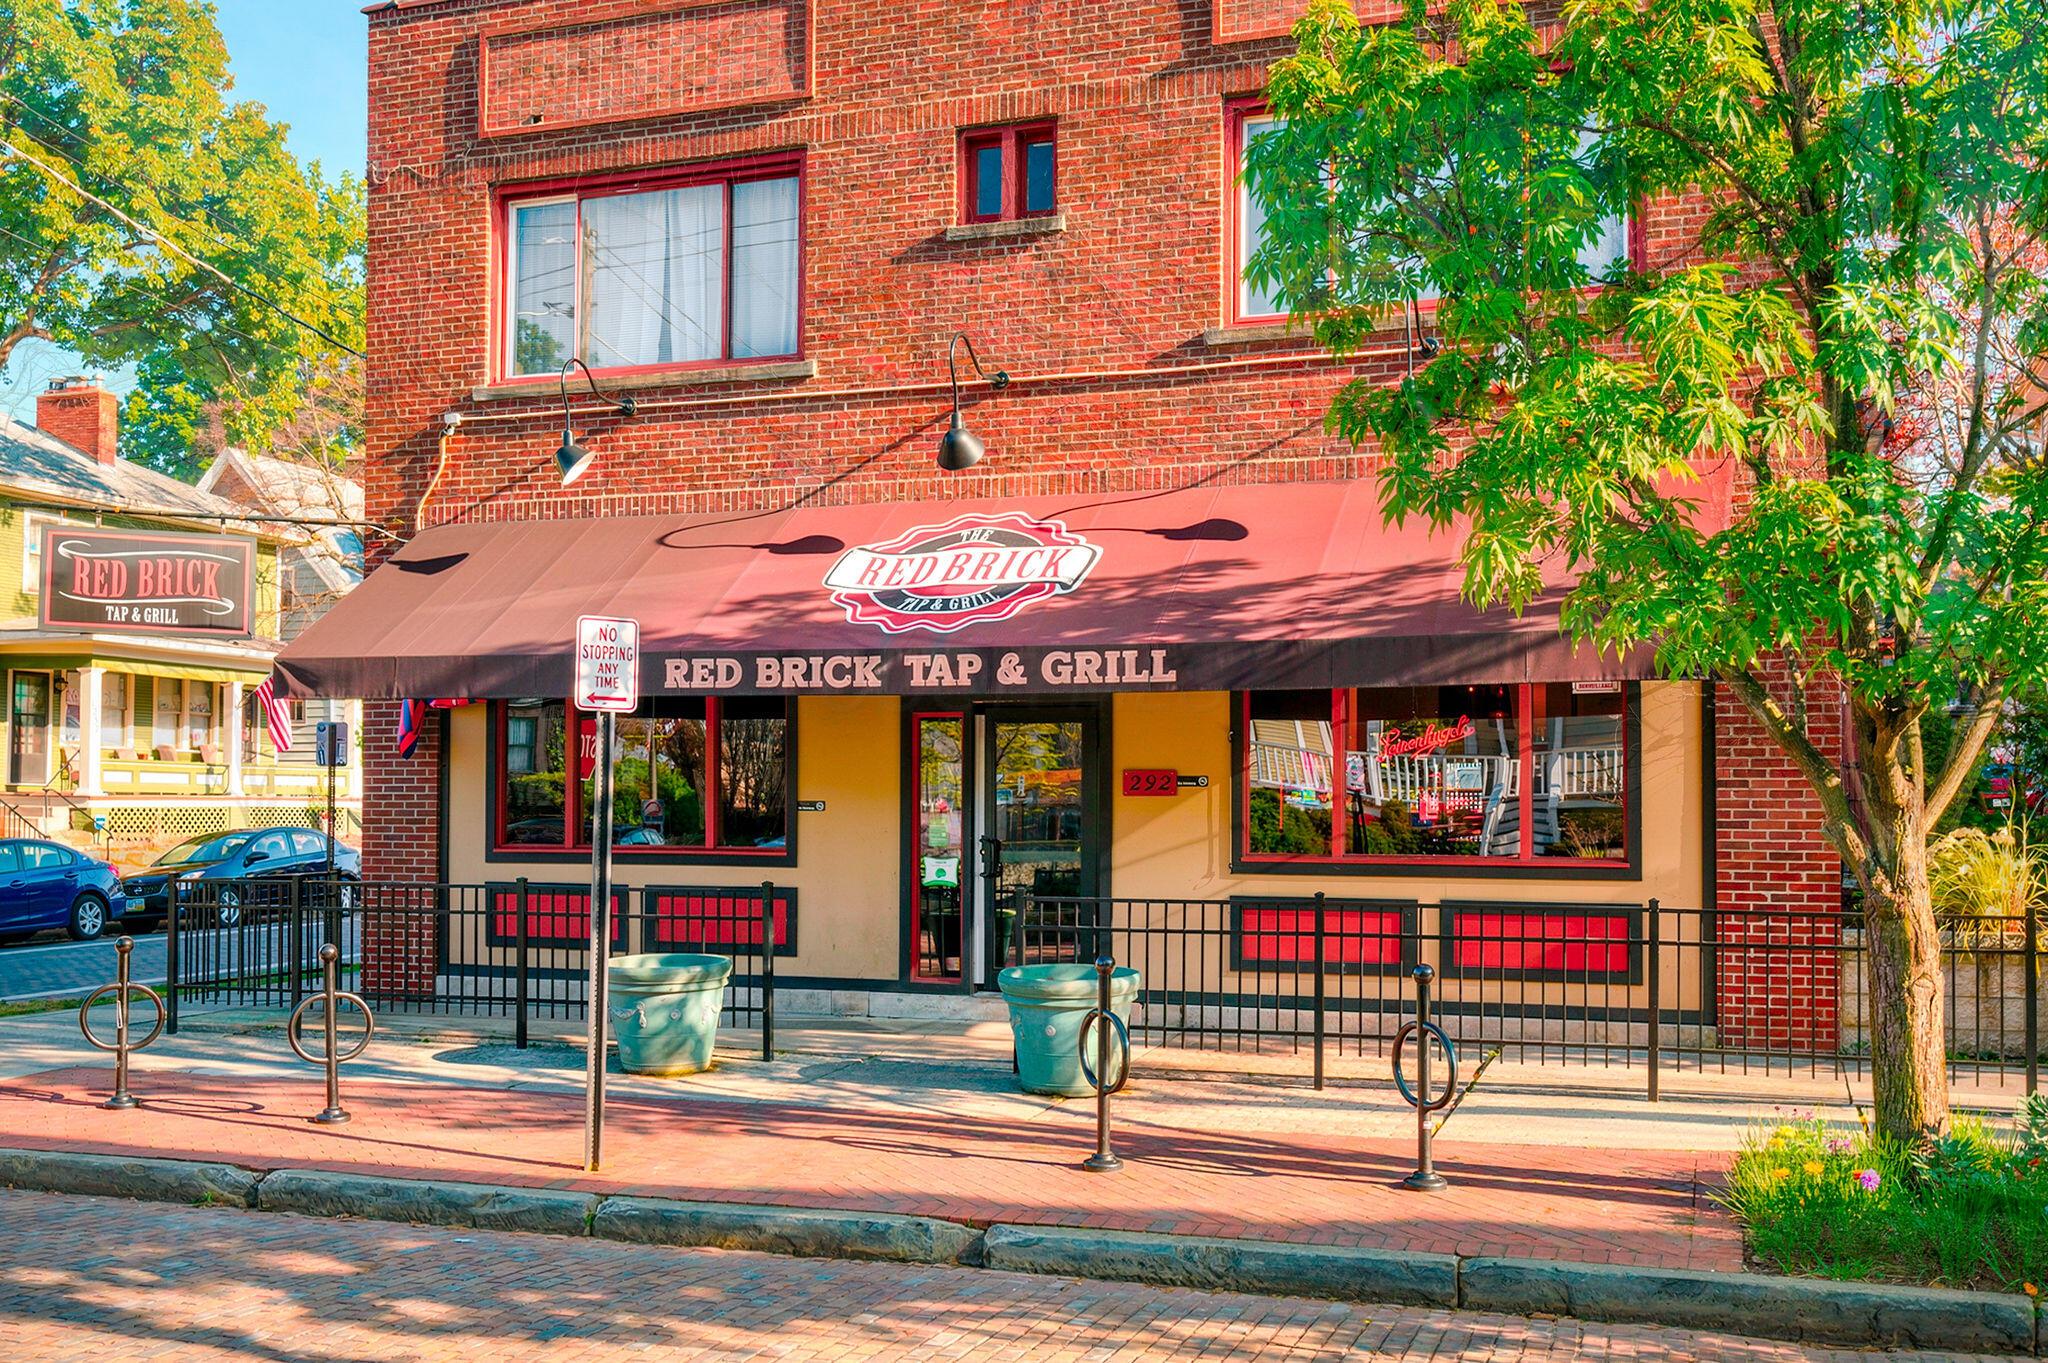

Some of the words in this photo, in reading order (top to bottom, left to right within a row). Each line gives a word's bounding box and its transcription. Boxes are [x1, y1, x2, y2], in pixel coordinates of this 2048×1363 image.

[960, 529, 995, 543] THE
[856, 555, 939, 587] RED
[940, 548, 1074, 584] BRICK
[72, 556, 128, 599] RED
[136, 557, 222, 600] BRICK
[896, 597, 930, 611] TAP
[930, 599, 943, 611] &
[948, 591, 1002, 611] GRILL
[105, 605, 130, 623] TAP
[131, 606, 141, 623] &
[143, 607, 179, 625] GRILL
[599, 627, 618, 643] NO
[582, 644, 633, 662] STOPPING
[597, 662, 619, 675] ANY
[663, 657, 743, 690] RED
[755, 655, 883, 690] BRICK
[903, 652, 983, 688] TAP
[996, 651, 1028, 686] &
[1041, 648, 1177, 685] GRILL
[594, 676, 620, 689] TIME
[1129, 774, 1171, 791] 292
